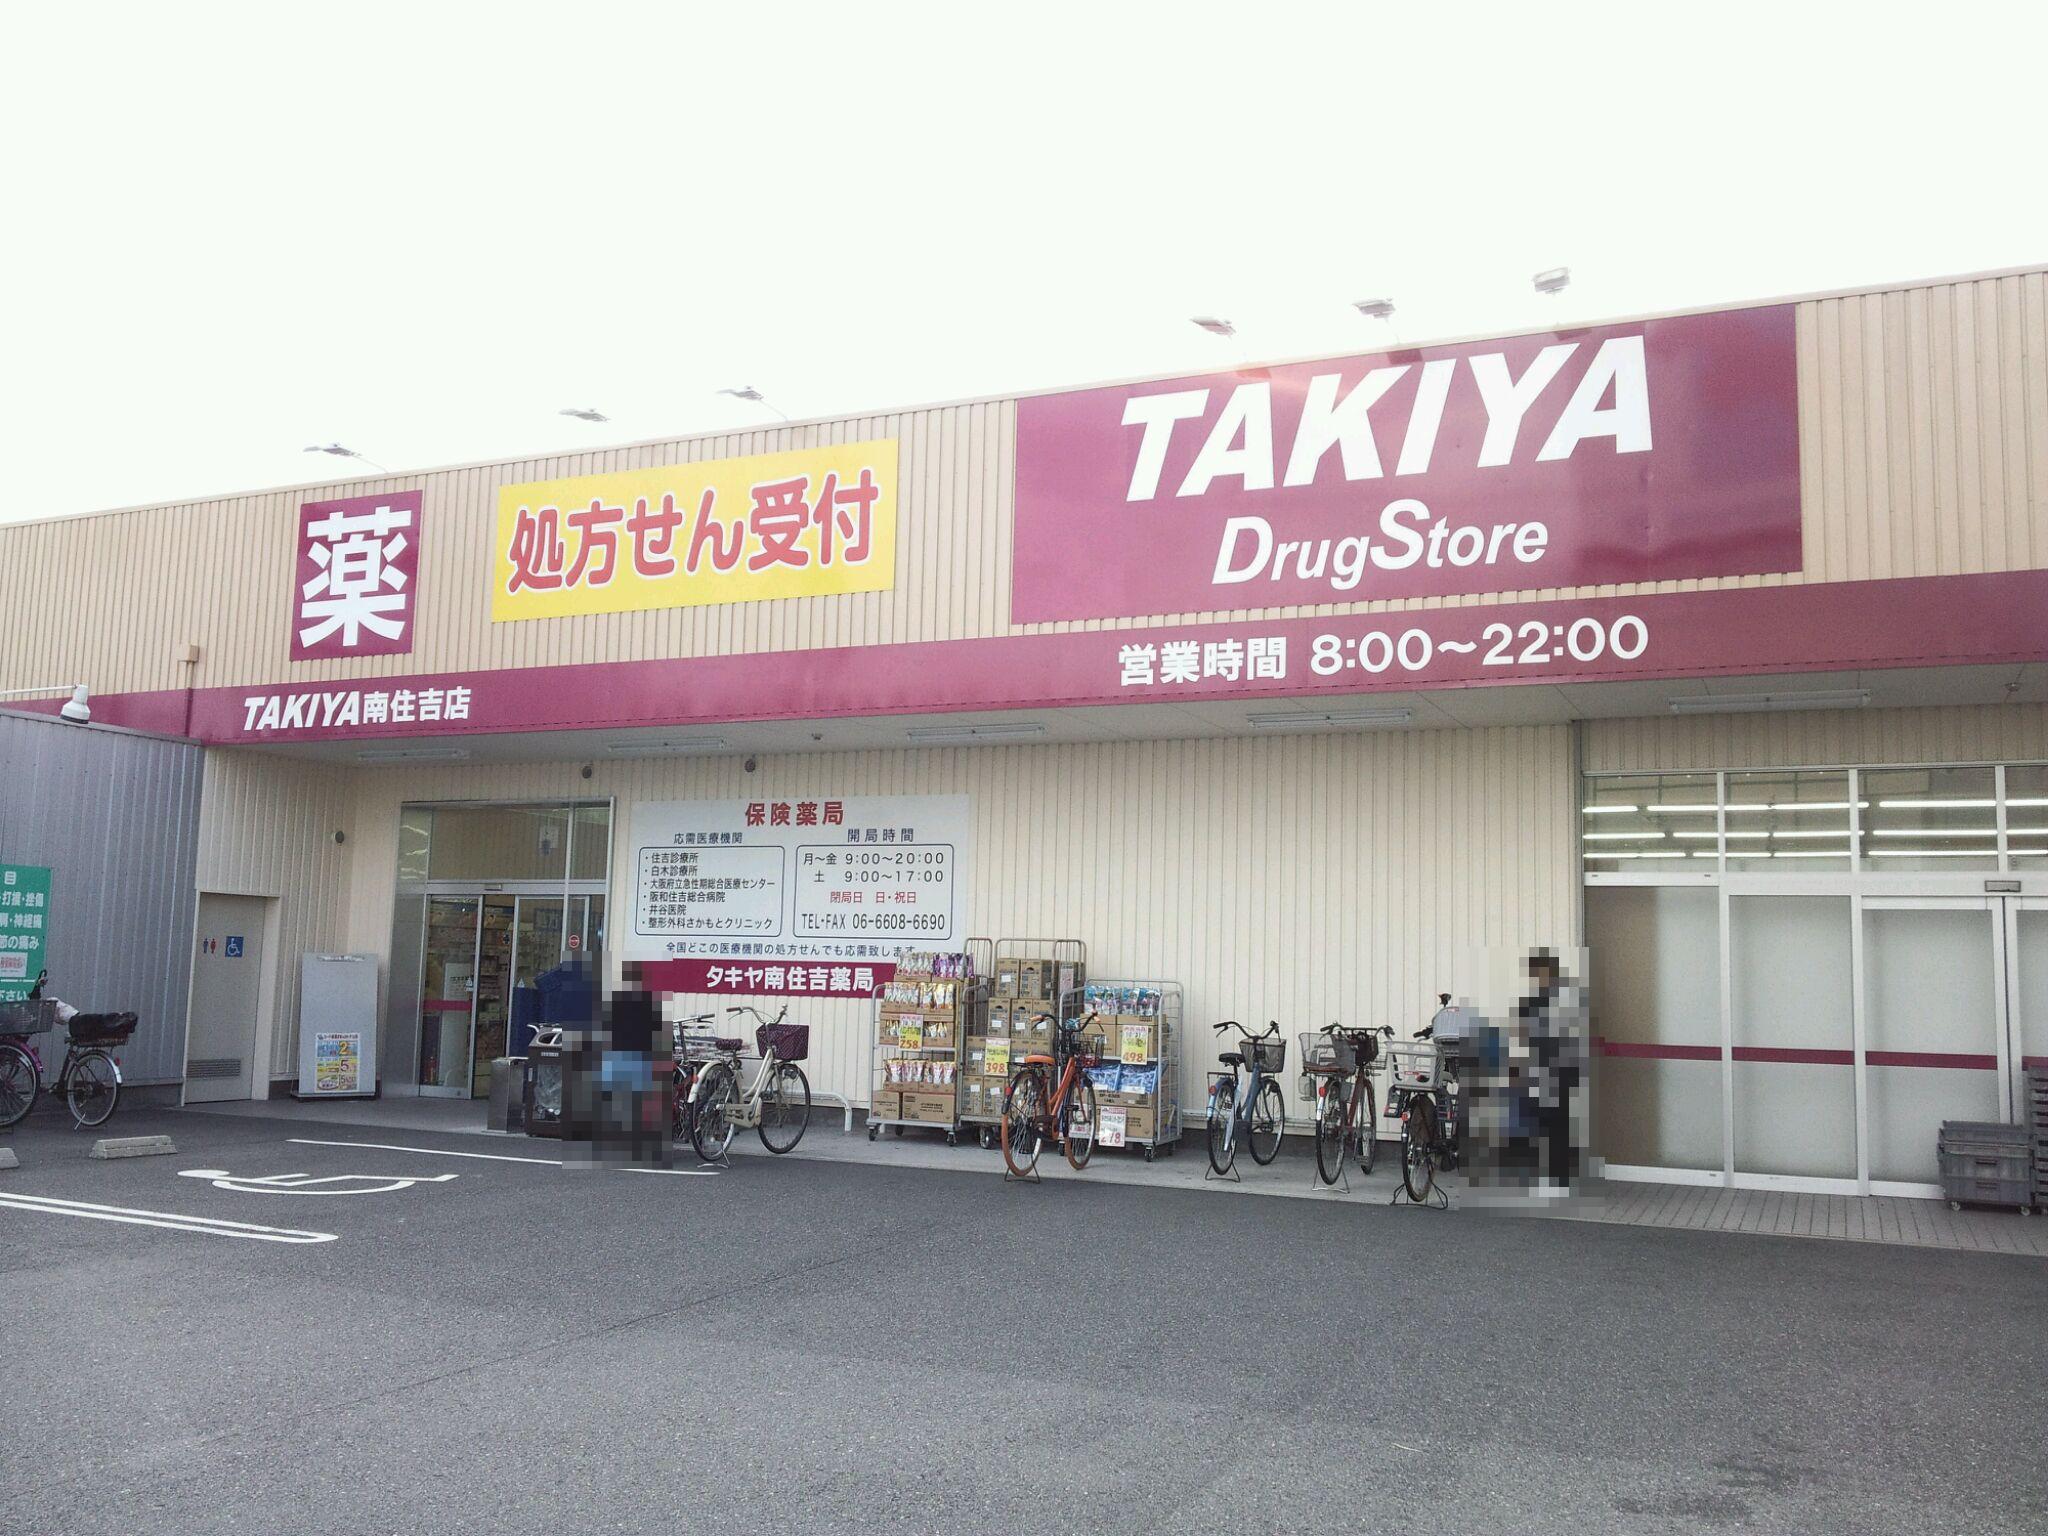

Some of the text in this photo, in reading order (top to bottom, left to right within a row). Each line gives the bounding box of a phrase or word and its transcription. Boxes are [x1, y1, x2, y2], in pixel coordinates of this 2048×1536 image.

[1120, 335, 1652, 502] TAKIYA
[506, 468, 880, 594] 処方せん受付
[1211, 498, 1549, 590] DrugStore
[299, 505, 412, 649] 薬
[1118, 614, 1650, 686] 営業時間 8:00～22:00
[745, 801, 844, 827] 保険薬局
[673, 832, 743, 845] 応需医療機関
[847, 828, 914, 842] 開局時間
[803, 852, 944, 866] 月～金 9:00～20:00
[813, 869, 944, 883] 土 9:00～17:00
[829, 891, 917, 904] 閉局日 日・祝日
[852, 913, 945, 930] 06-6608-6690
[706, 966, 874, 992] タキヤ南住吉薬局
